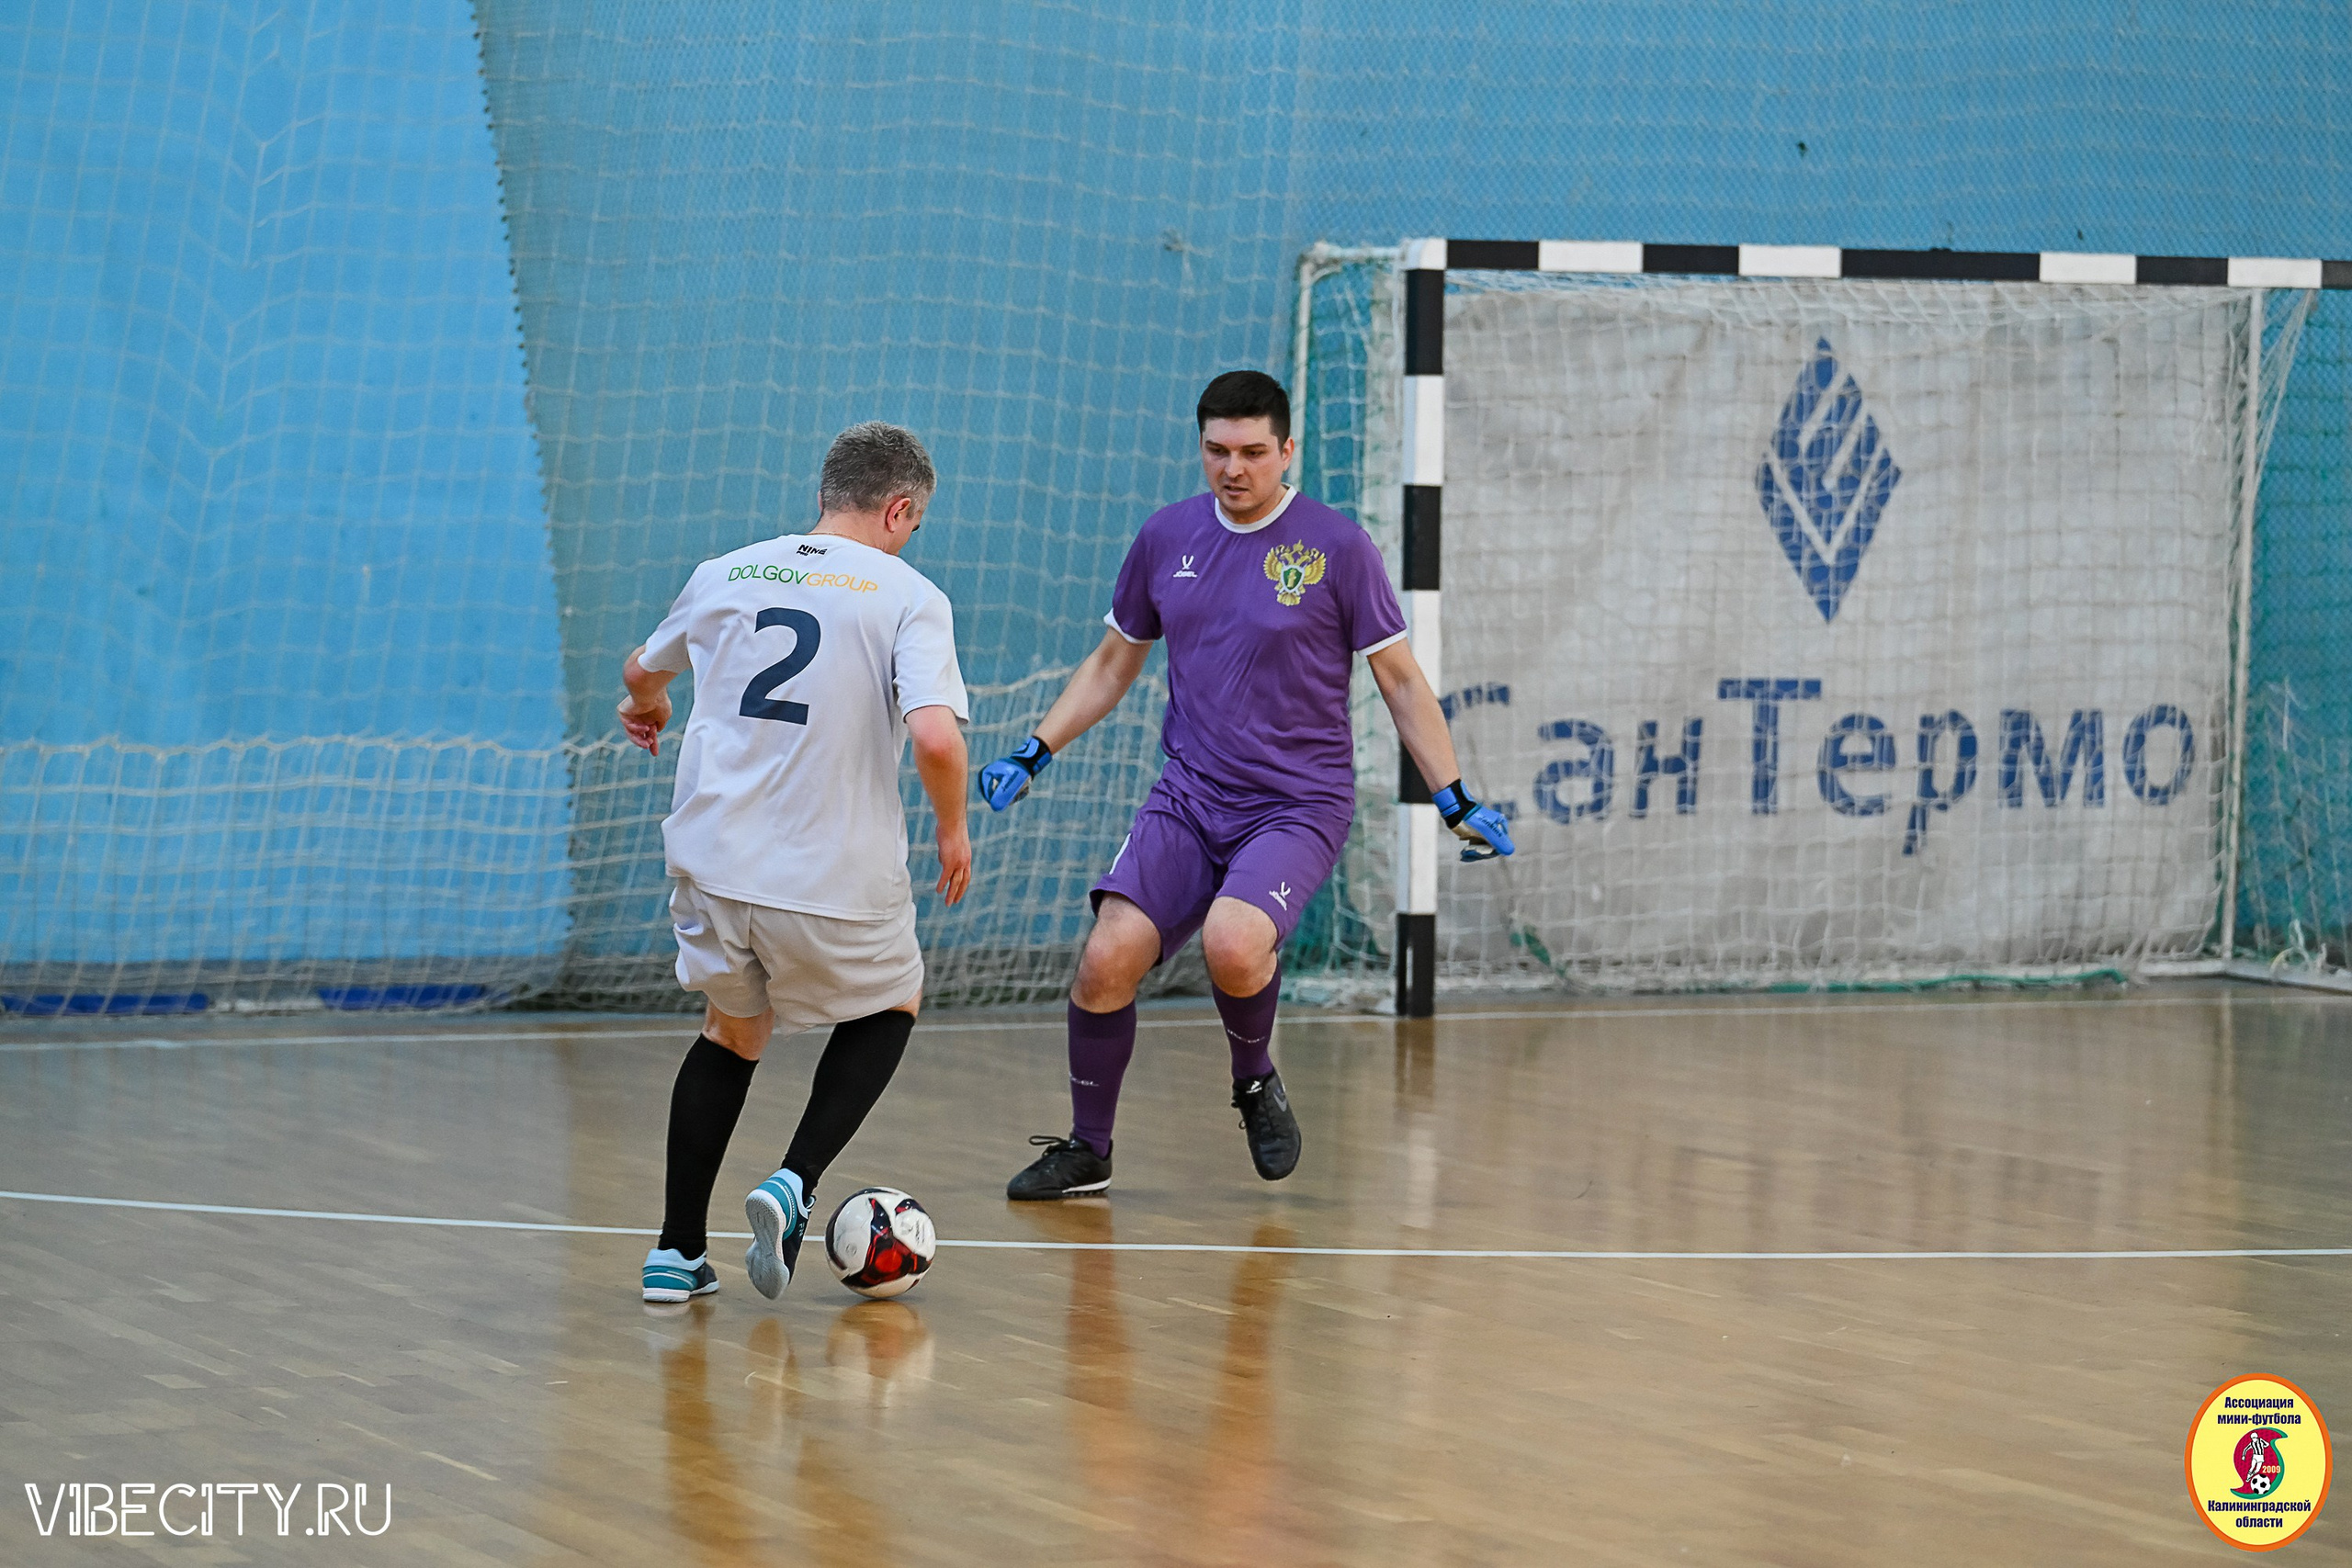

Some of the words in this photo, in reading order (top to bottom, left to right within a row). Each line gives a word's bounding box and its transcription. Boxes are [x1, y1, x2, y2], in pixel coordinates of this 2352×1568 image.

[798, 544, 827, 555] NINE
[728, 564, 878, 592] DOLGOVGROUP
[739, 606, 821, 726] 2
